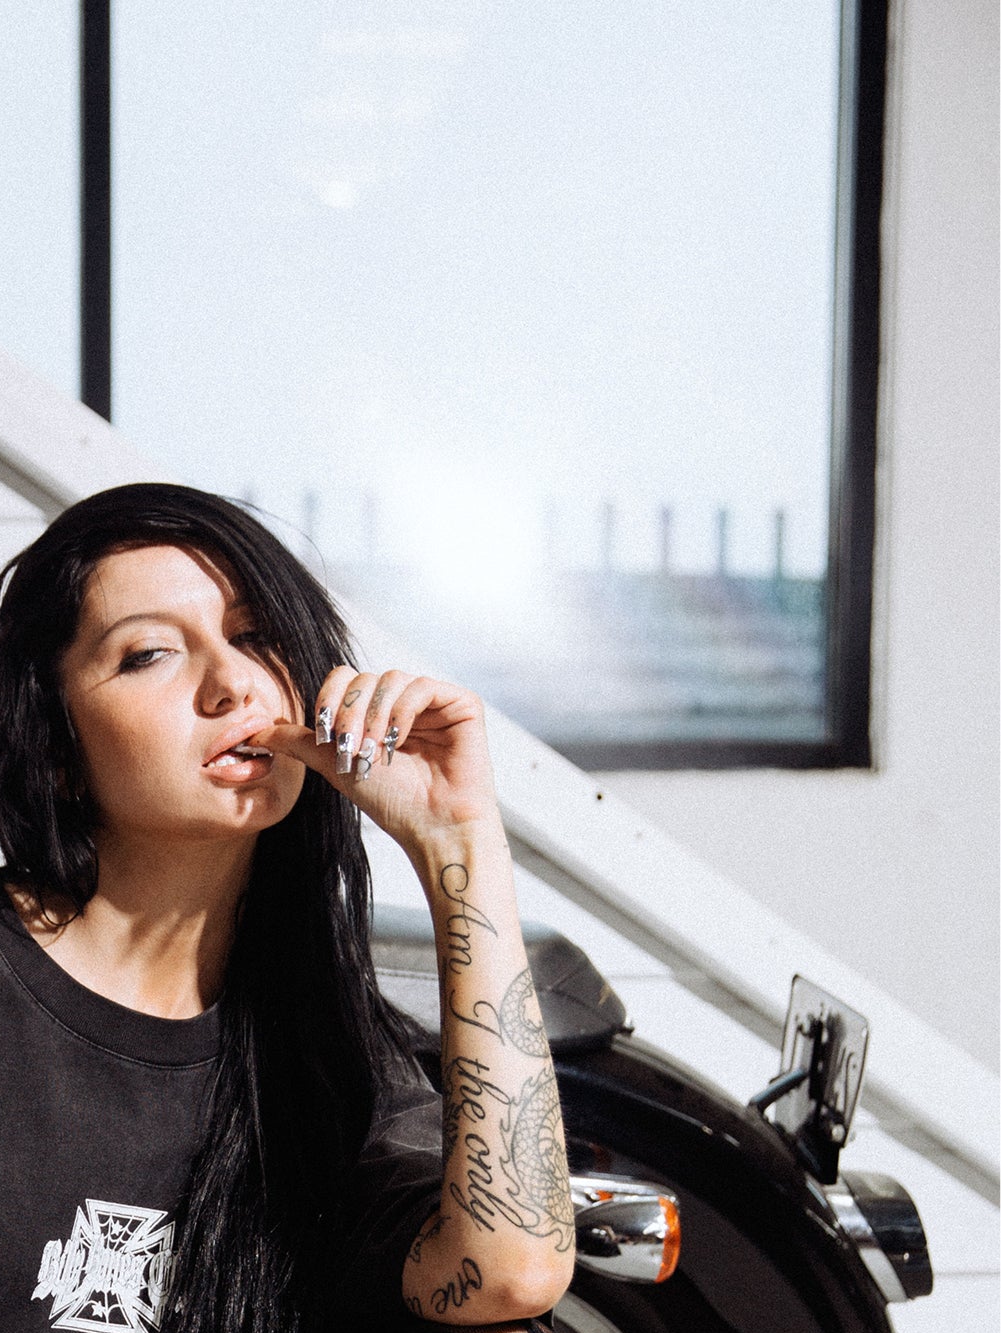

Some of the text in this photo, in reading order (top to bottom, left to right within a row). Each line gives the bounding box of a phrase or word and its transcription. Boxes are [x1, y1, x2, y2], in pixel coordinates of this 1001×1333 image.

[440, 863, 498, 975] Am
[454, 1056, 513, 1124] the
[450, 1134, 527, 1233] only
[431, 1257, 483, 1315] one
